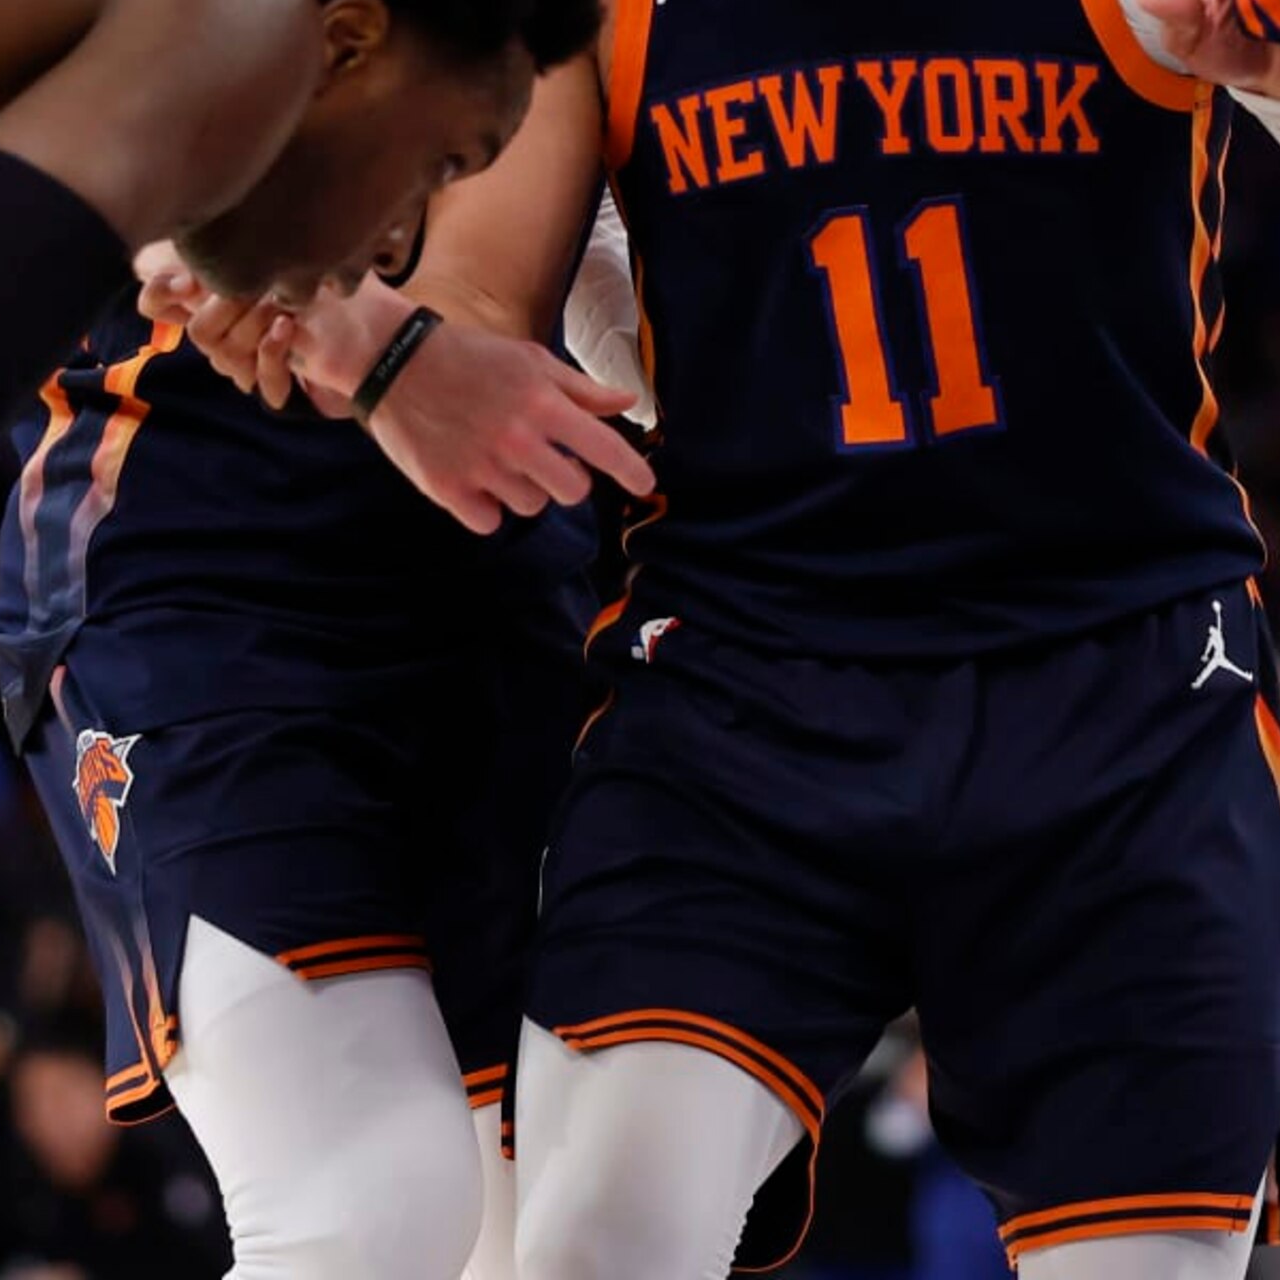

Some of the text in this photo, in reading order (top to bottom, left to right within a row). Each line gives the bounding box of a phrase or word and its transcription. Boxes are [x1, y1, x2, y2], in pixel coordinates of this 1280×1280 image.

[649, 57, 1100, 195] NEW YORK
[808, 201, 1002, 448] 11
